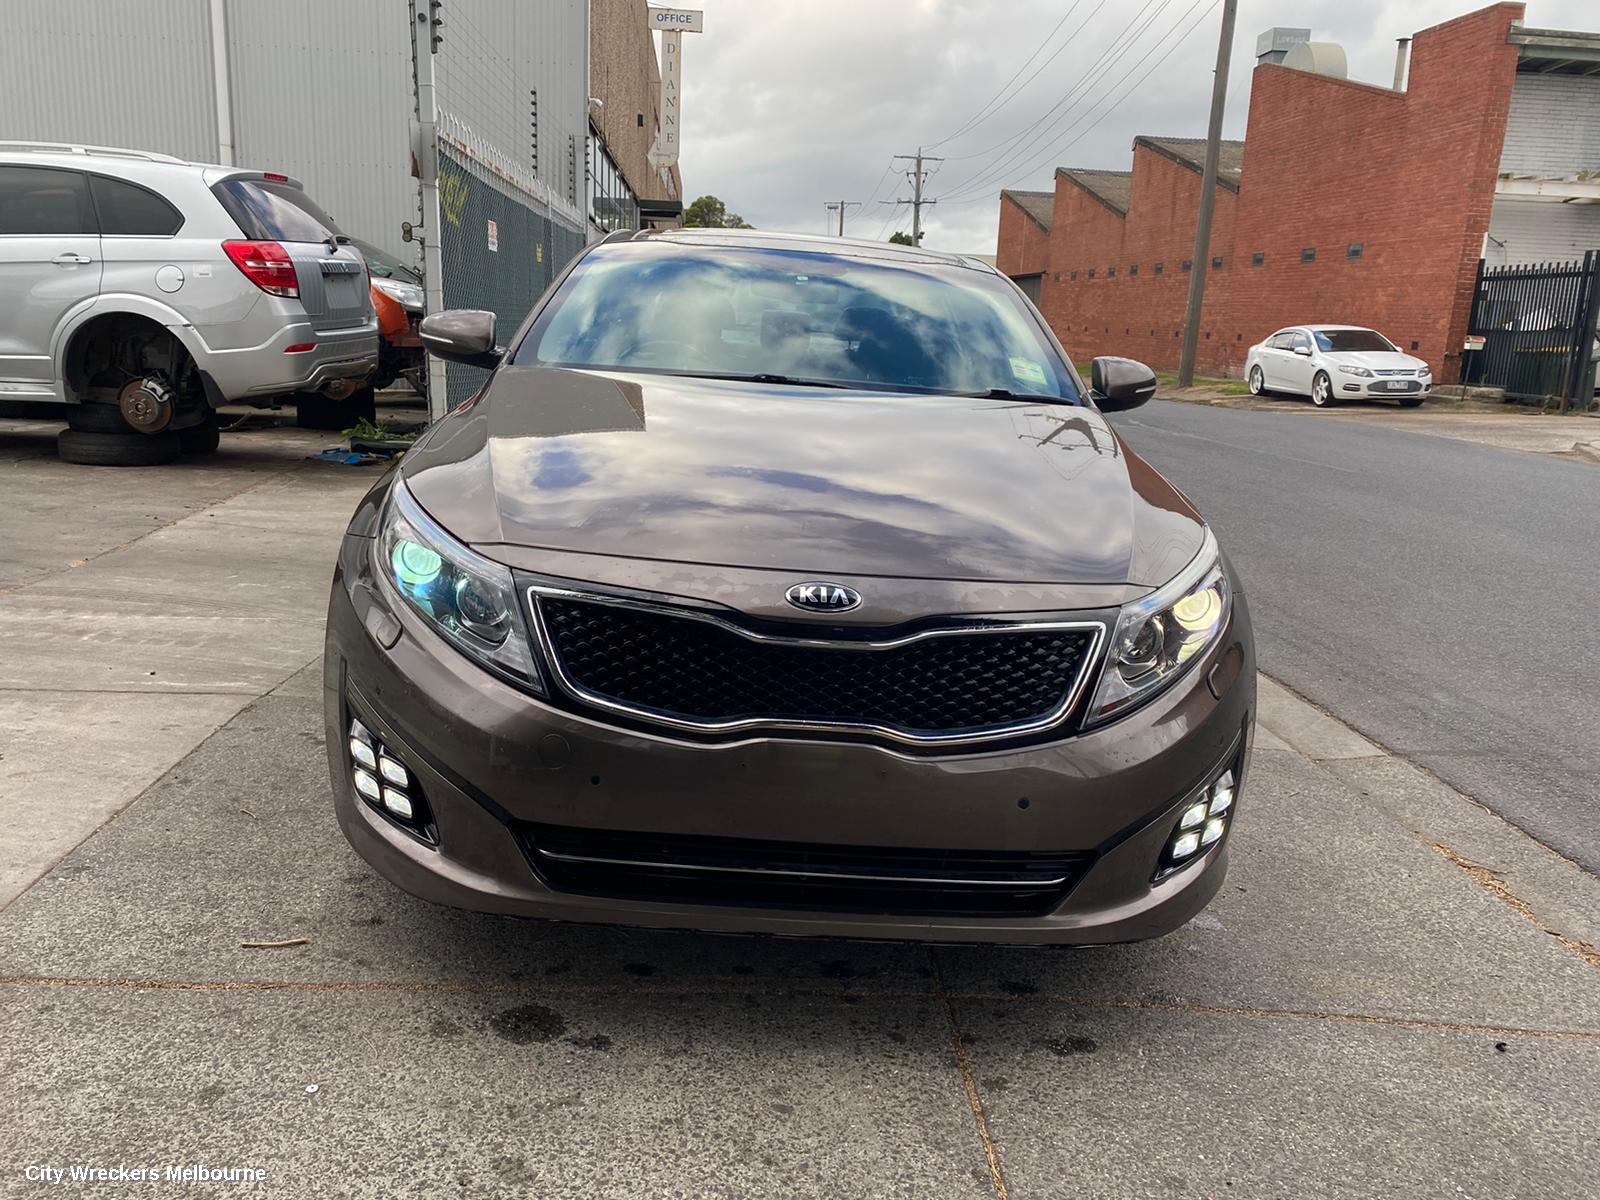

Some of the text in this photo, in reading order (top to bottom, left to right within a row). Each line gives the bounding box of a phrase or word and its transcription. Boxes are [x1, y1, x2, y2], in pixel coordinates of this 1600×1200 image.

[656, 13, 692, 23] OFFICE
[666, 43, 676, 144] DIANNE
[799, 586, 850, 605] KIA
